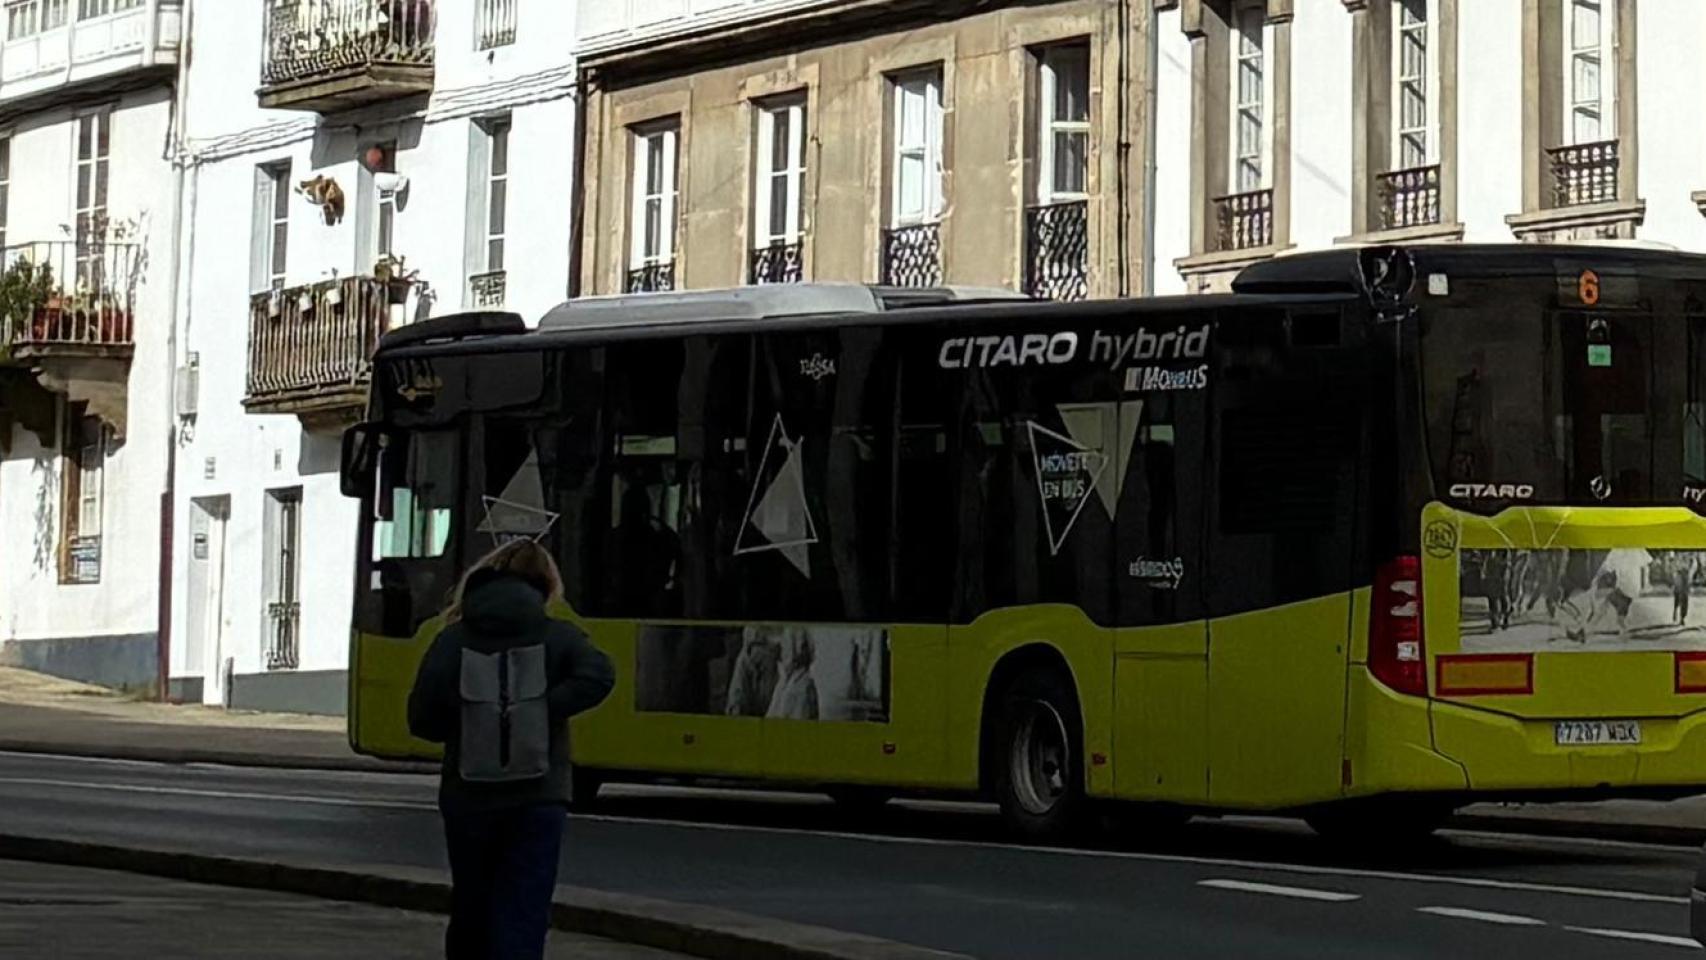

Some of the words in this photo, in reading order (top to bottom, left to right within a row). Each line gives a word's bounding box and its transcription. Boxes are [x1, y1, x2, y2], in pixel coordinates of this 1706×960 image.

[1579, 269, 1599, 305] 6
[938, 331, 1078, 368] CITARO
[1088, 324, 1211, 370] hybrid
[1449, 483, 1533, 499] CITARO
